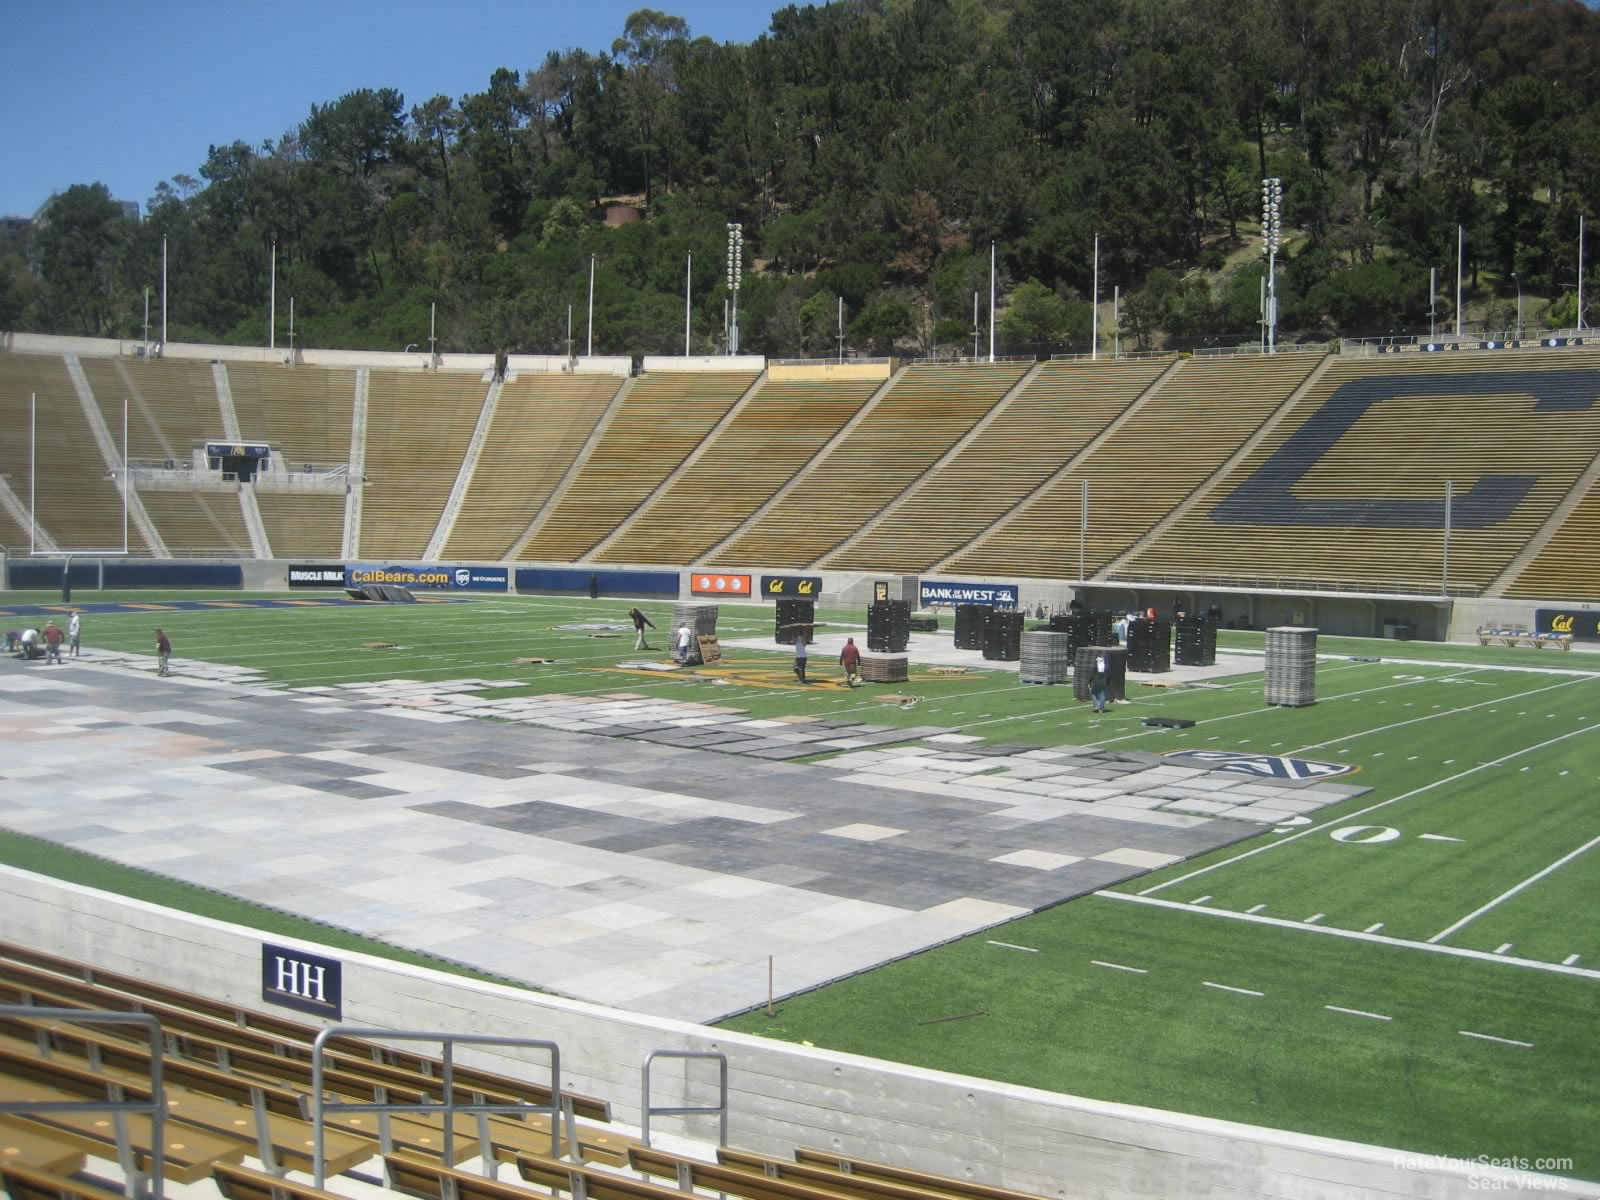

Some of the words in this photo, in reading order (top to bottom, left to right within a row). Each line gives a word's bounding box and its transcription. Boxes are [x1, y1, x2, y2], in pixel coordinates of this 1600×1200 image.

[290, 571, 322, 581] MUSCLE
[323, 571, 344, 581] MILK
[351, 570, 449, 583] CalBears.com
[769, 580, 784, 592] Cal
[798, 580, 813, 593] Cal
[876, 588, 886, 601] 12
[922, 587, 952, 599] BANK
[962, 590, 995, 601] WEST
[1552, 615, 1574, 632] Cal
[275, 956, 327, 1002] HH
